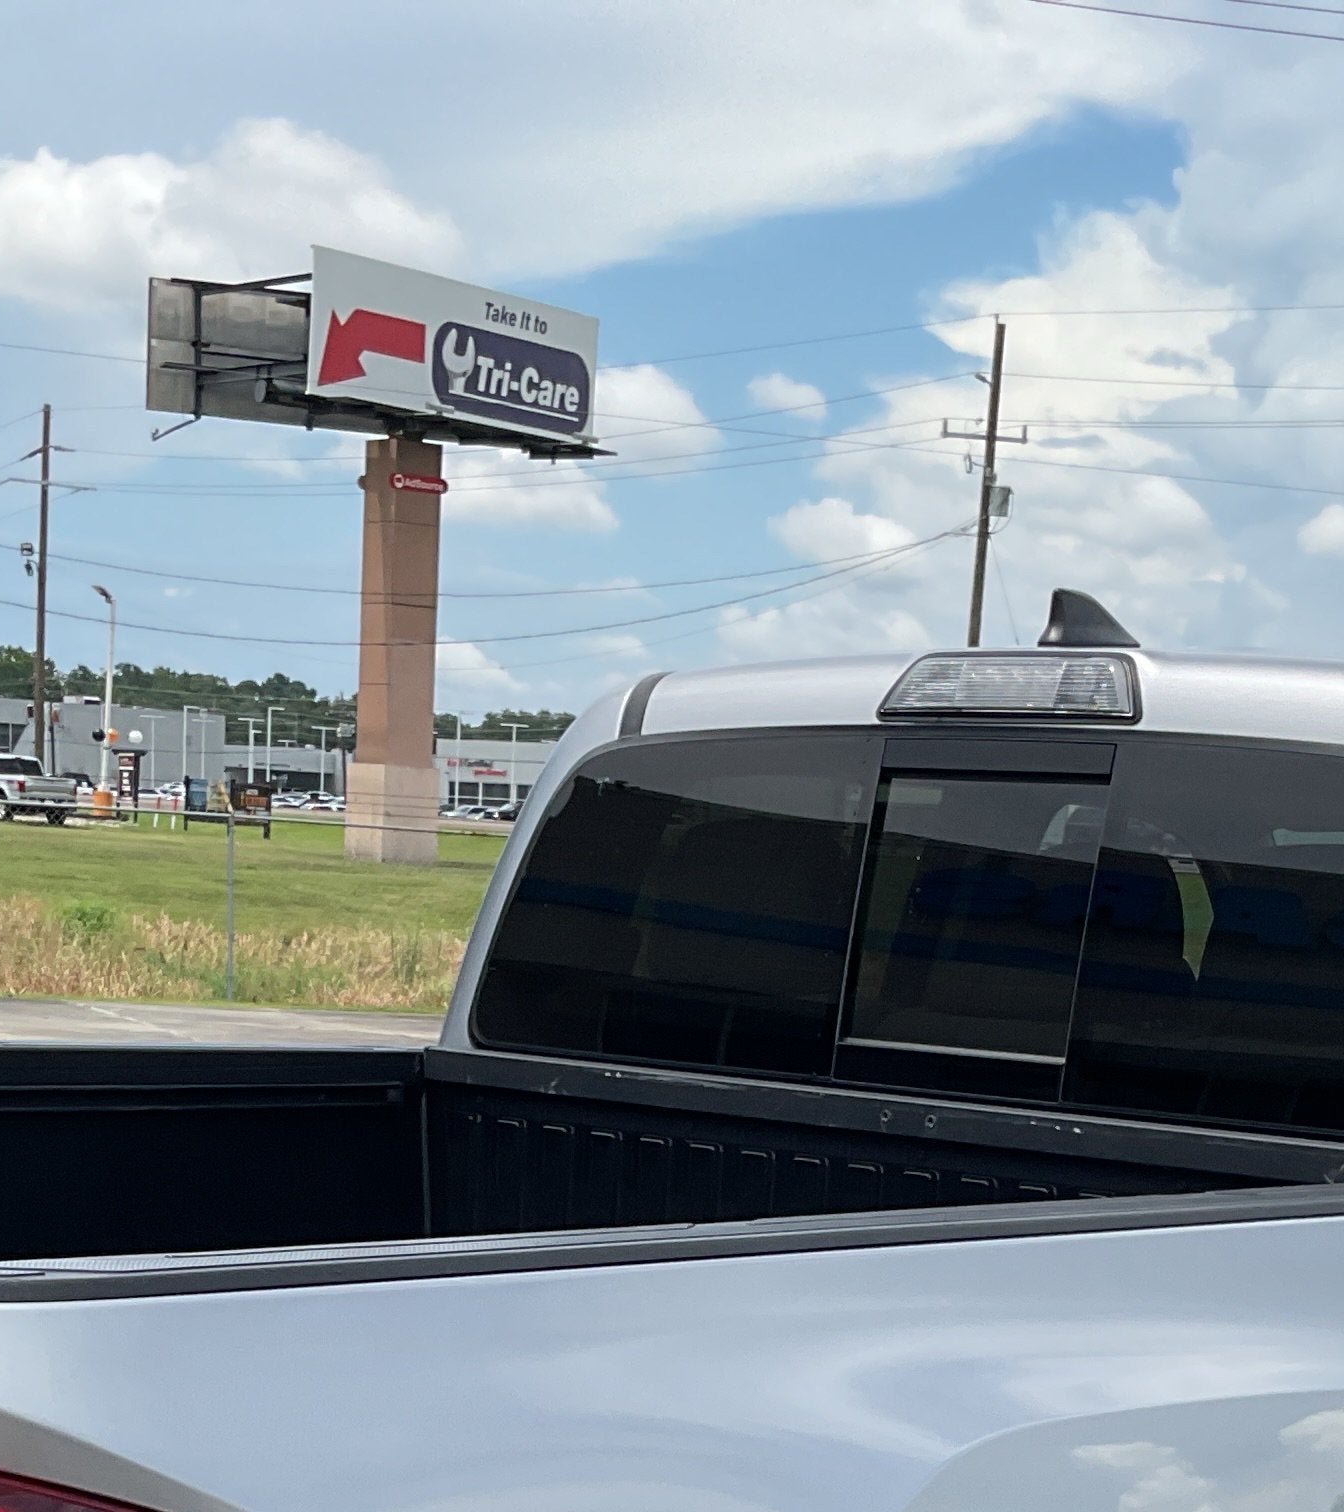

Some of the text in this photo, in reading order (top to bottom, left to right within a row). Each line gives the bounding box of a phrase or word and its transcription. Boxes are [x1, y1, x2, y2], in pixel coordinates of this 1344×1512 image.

[484, 301, 548, 335] Take It to
[476, 355, 580, 413] Tri-Care
